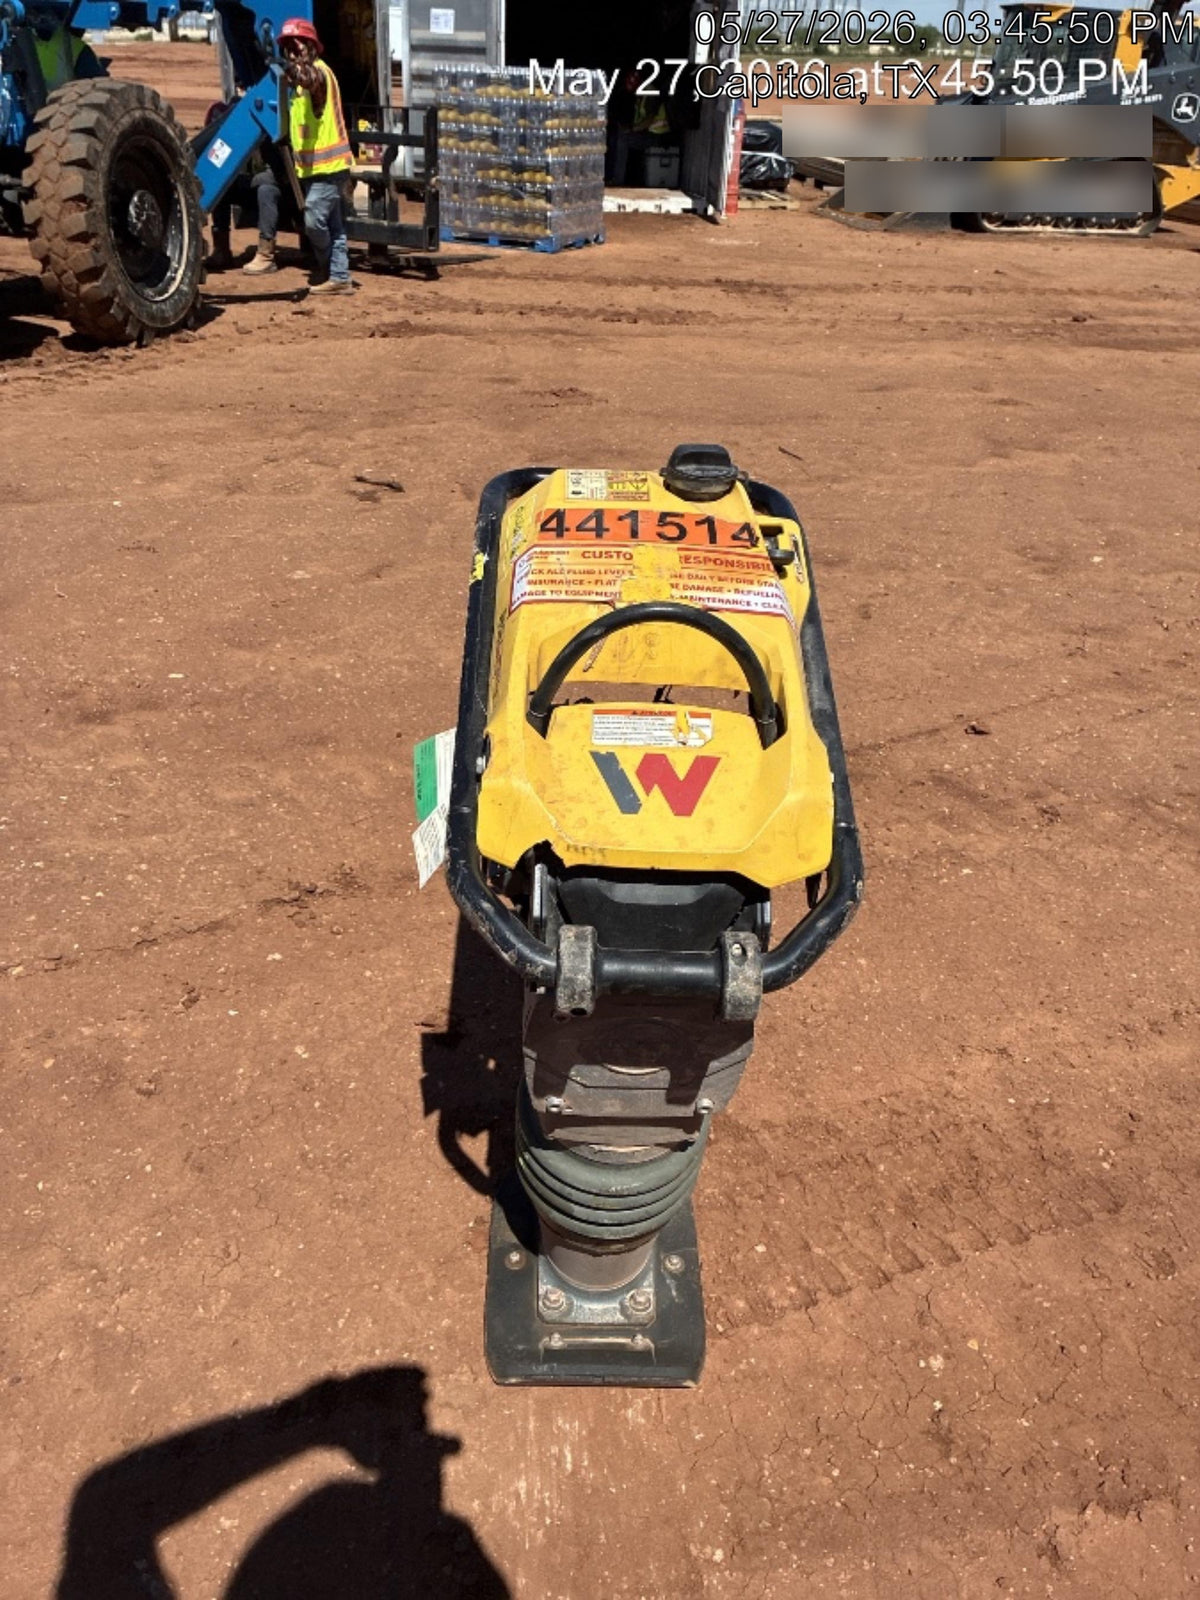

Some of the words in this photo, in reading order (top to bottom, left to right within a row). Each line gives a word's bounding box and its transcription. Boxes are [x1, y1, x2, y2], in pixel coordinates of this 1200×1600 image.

[540, 508, 760, 548] 441514
[581, 550, 634, 561] CUSTO
[527, 578, 584, 586] INSURANCE
